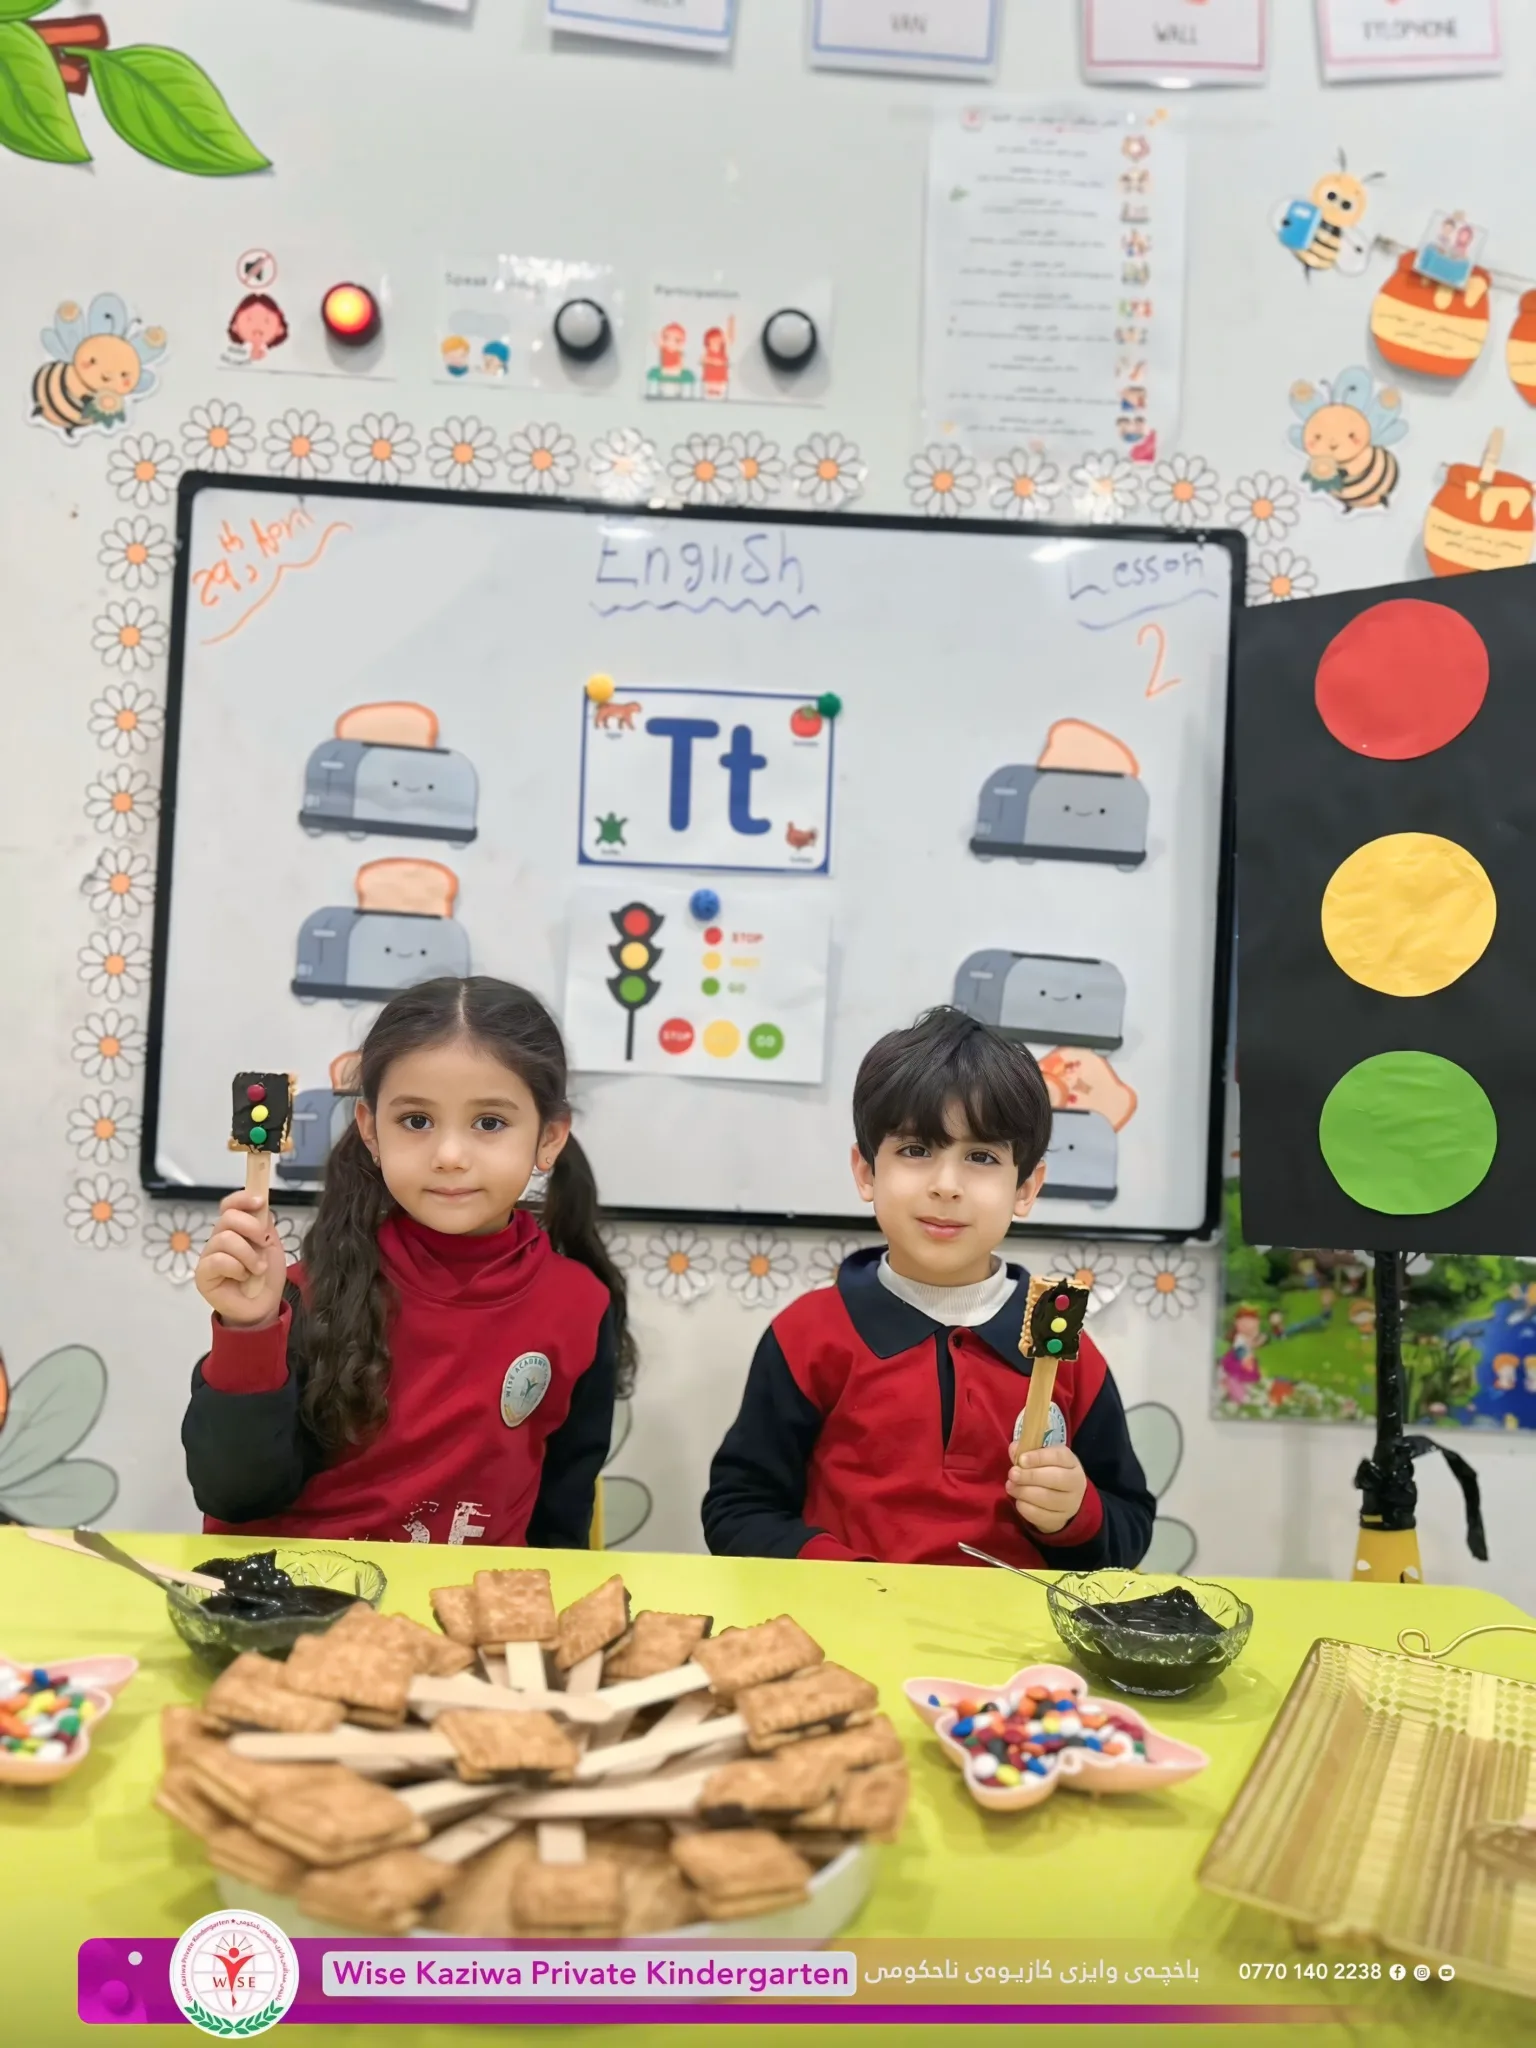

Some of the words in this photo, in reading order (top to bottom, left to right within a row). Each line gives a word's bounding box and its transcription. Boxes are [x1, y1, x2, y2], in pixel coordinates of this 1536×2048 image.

[1067, 549, 1205, 600] Lesson
[1137, 622, 1182, 699] 2
[644, 716, 772, 836] Tt
[755, 1033, 776, 1049] GO
